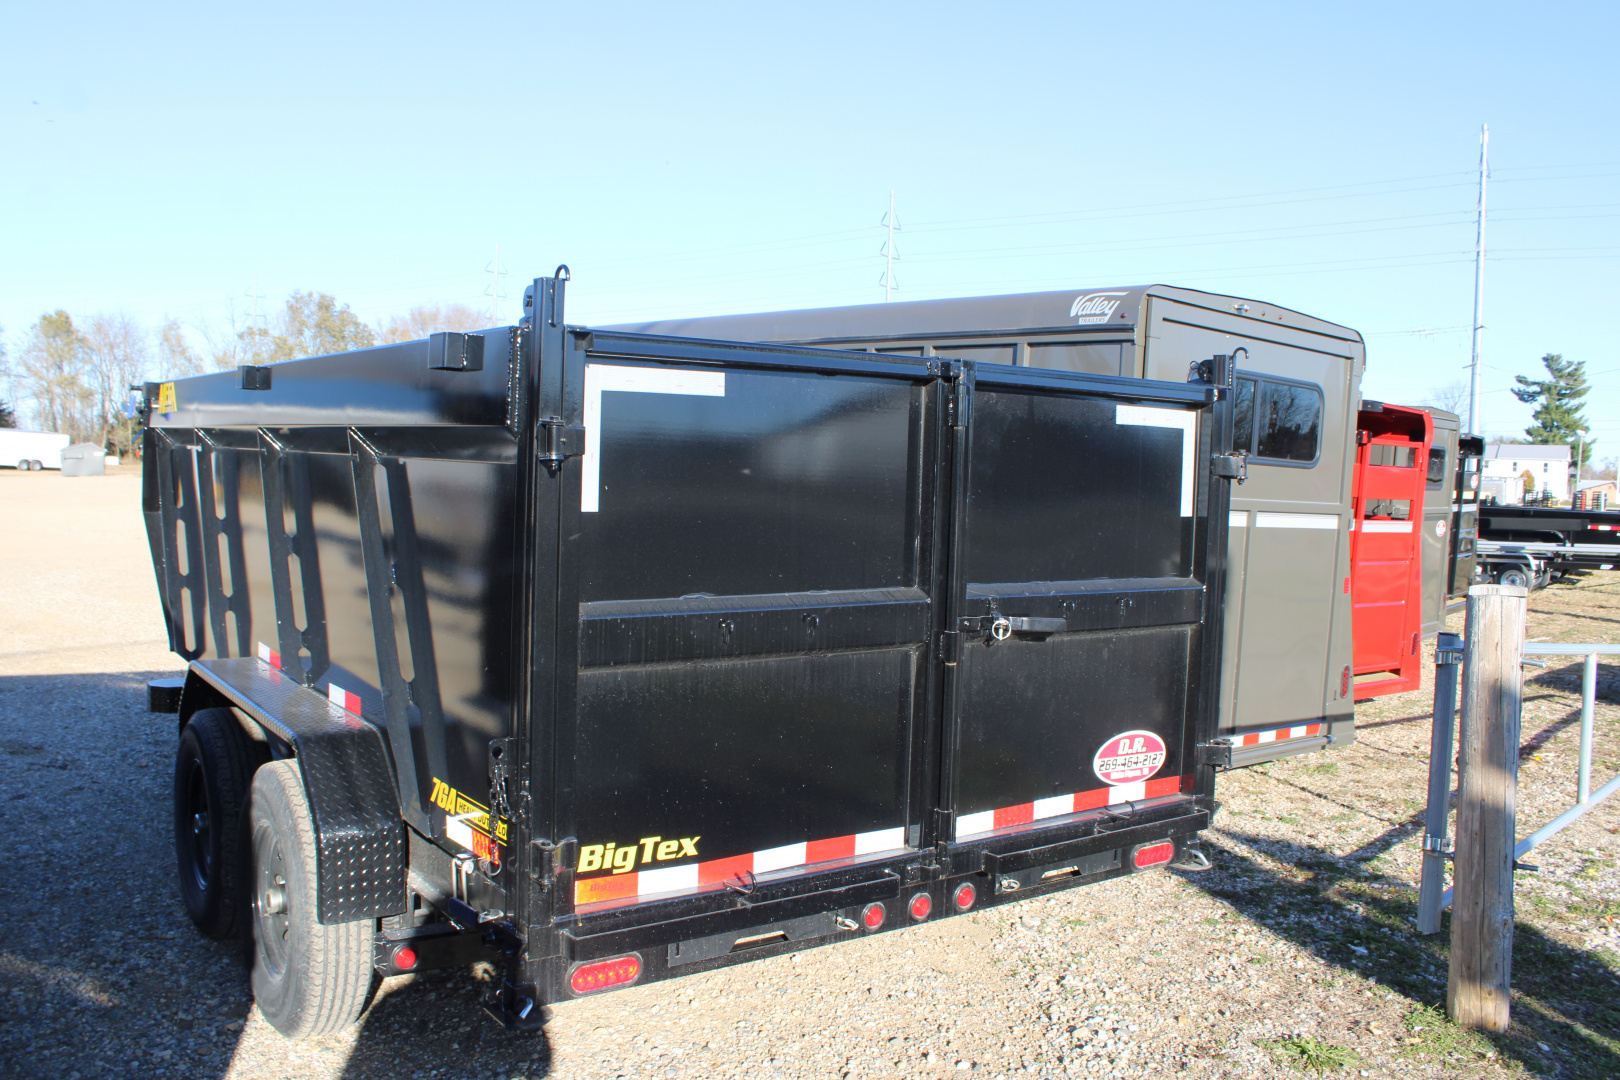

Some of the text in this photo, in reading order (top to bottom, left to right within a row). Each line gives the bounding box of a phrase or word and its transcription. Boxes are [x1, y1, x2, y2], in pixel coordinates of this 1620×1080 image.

[1070, 291, 1130, 321] Valley
[1117, 737, 1147, 755] D.R.
[430, 777, 457, 815] 7GA
